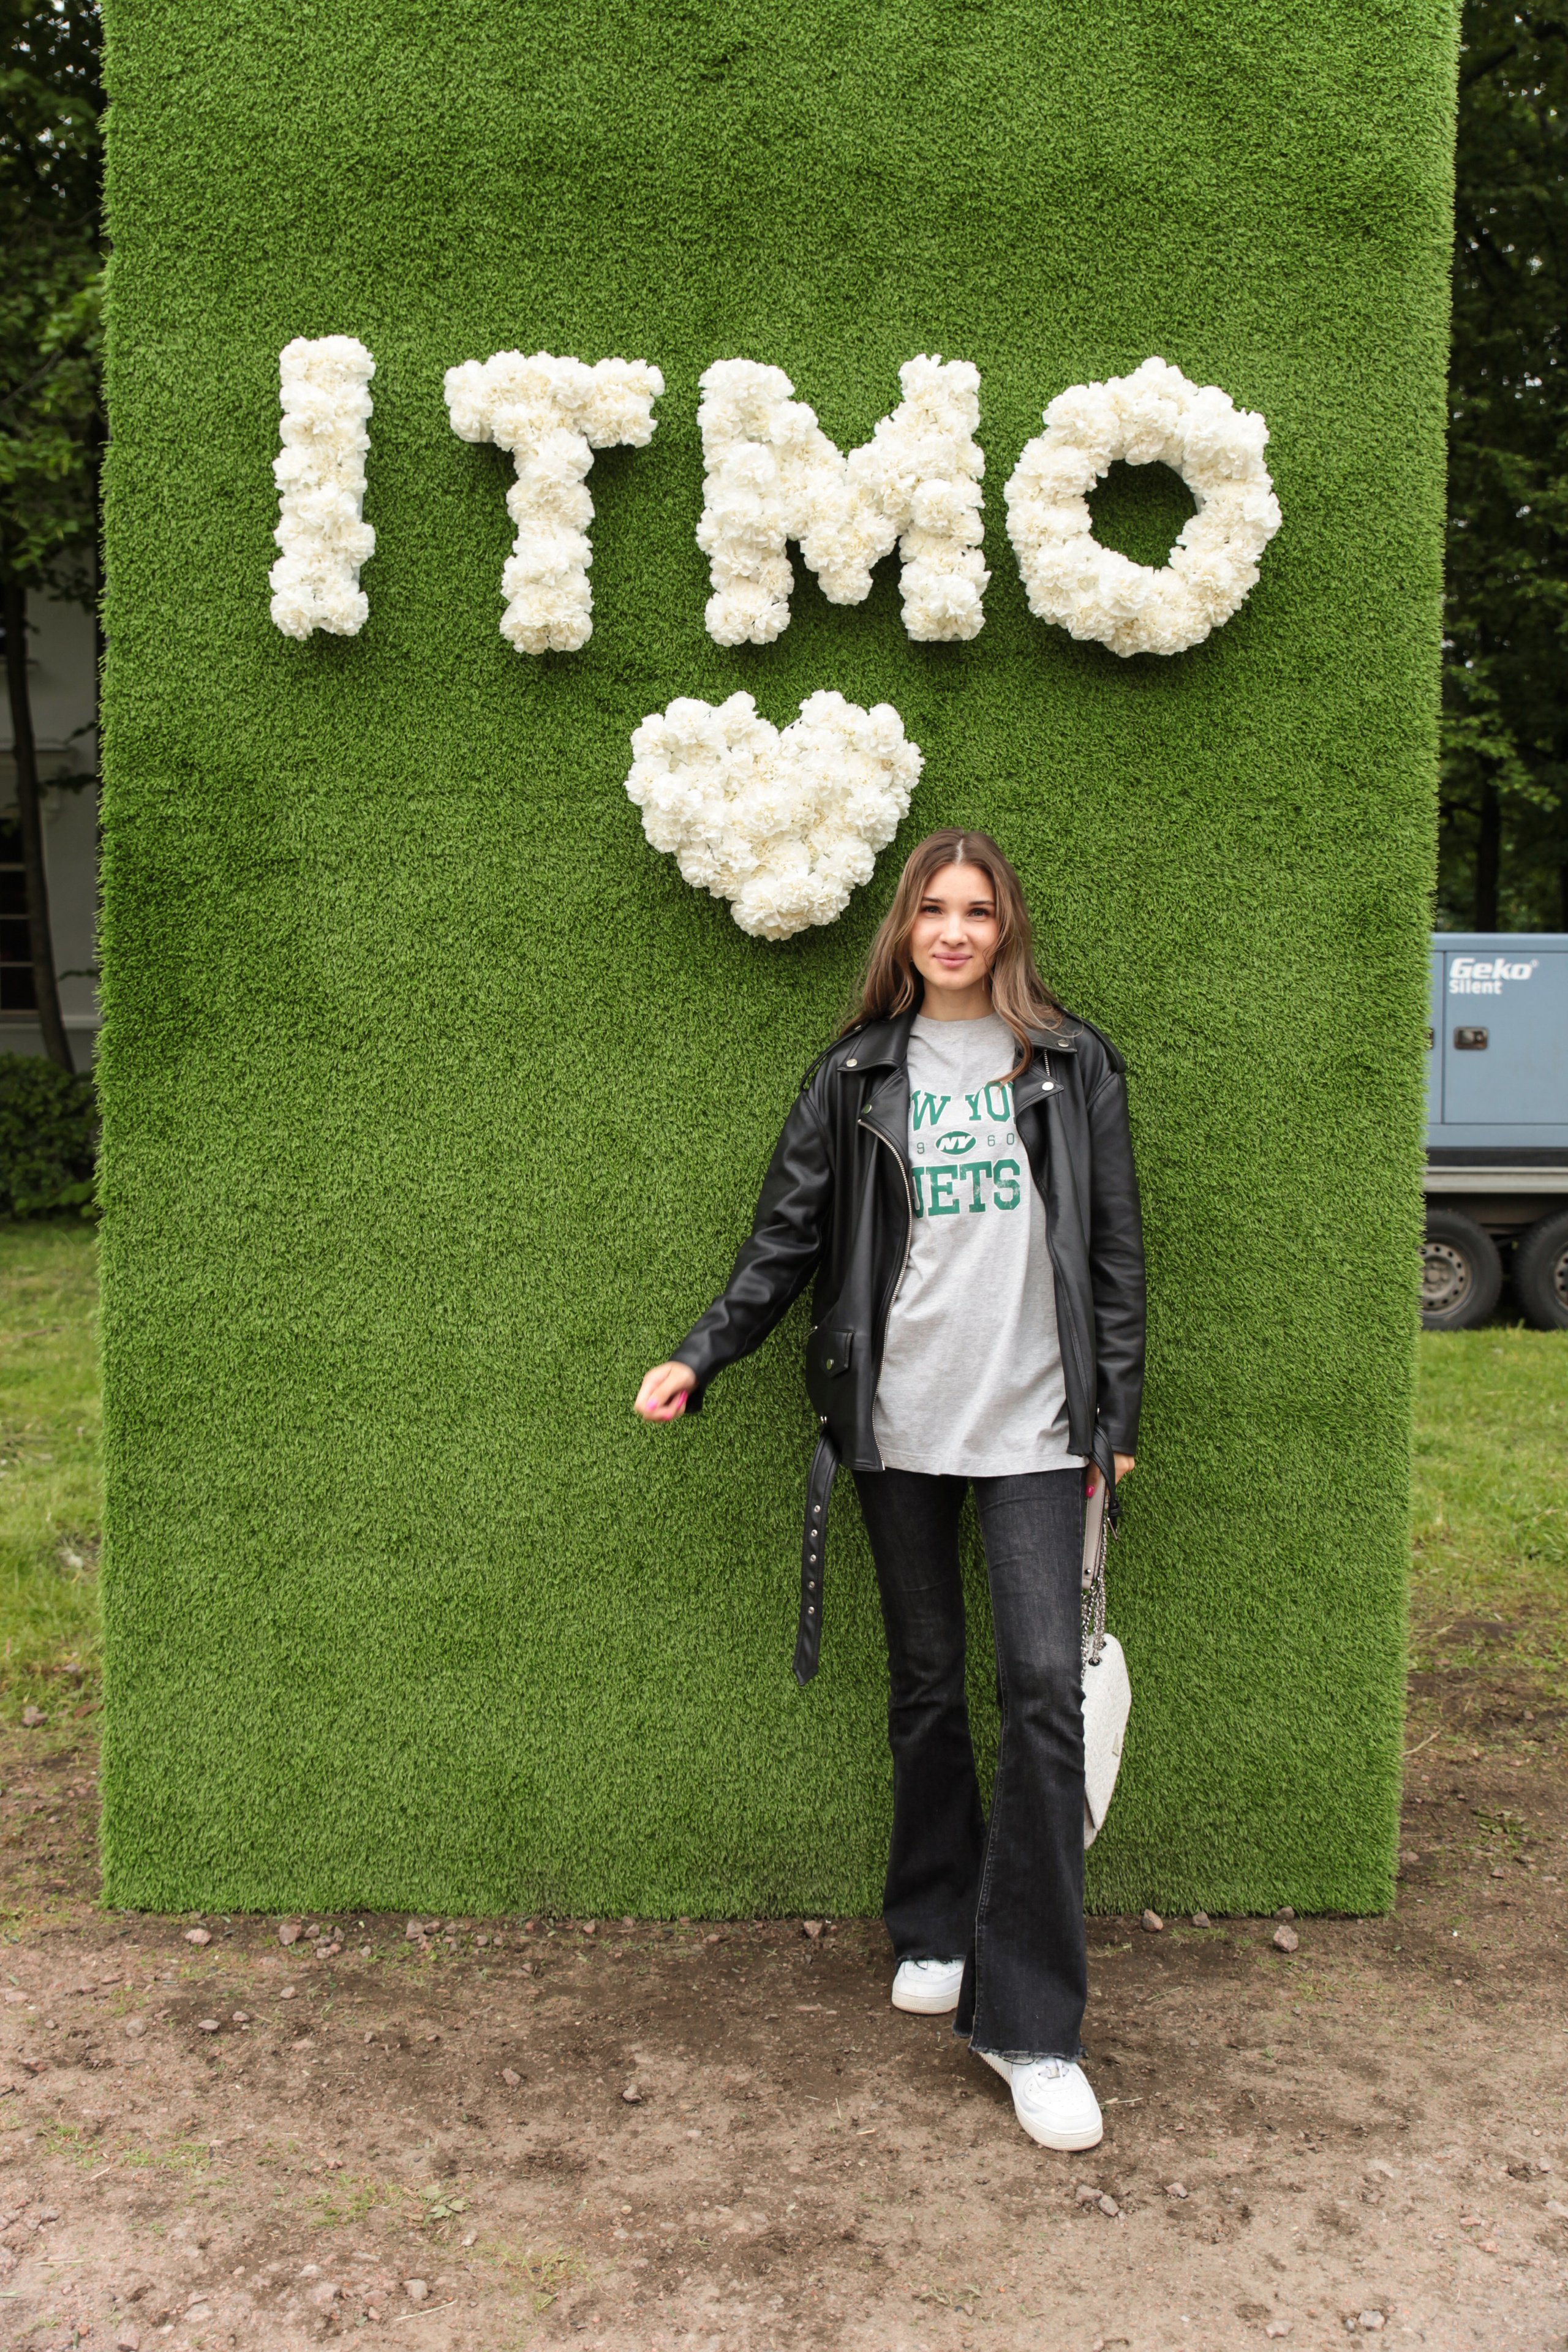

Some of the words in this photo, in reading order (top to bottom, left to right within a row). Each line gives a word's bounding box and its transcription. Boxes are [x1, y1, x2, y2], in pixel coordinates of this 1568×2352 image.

[270, 334, 1283, 658] ITMO
[1449, 957, 1532, 980] Geko
[1449, 979, 1503, 995] Silent
[908, 1090, 951, 1131] W
[965, 1081, 1016, 1125] YO
[938, 1135, 974, 1151] NY
[911, 1158, 1020, 1218] JETS
